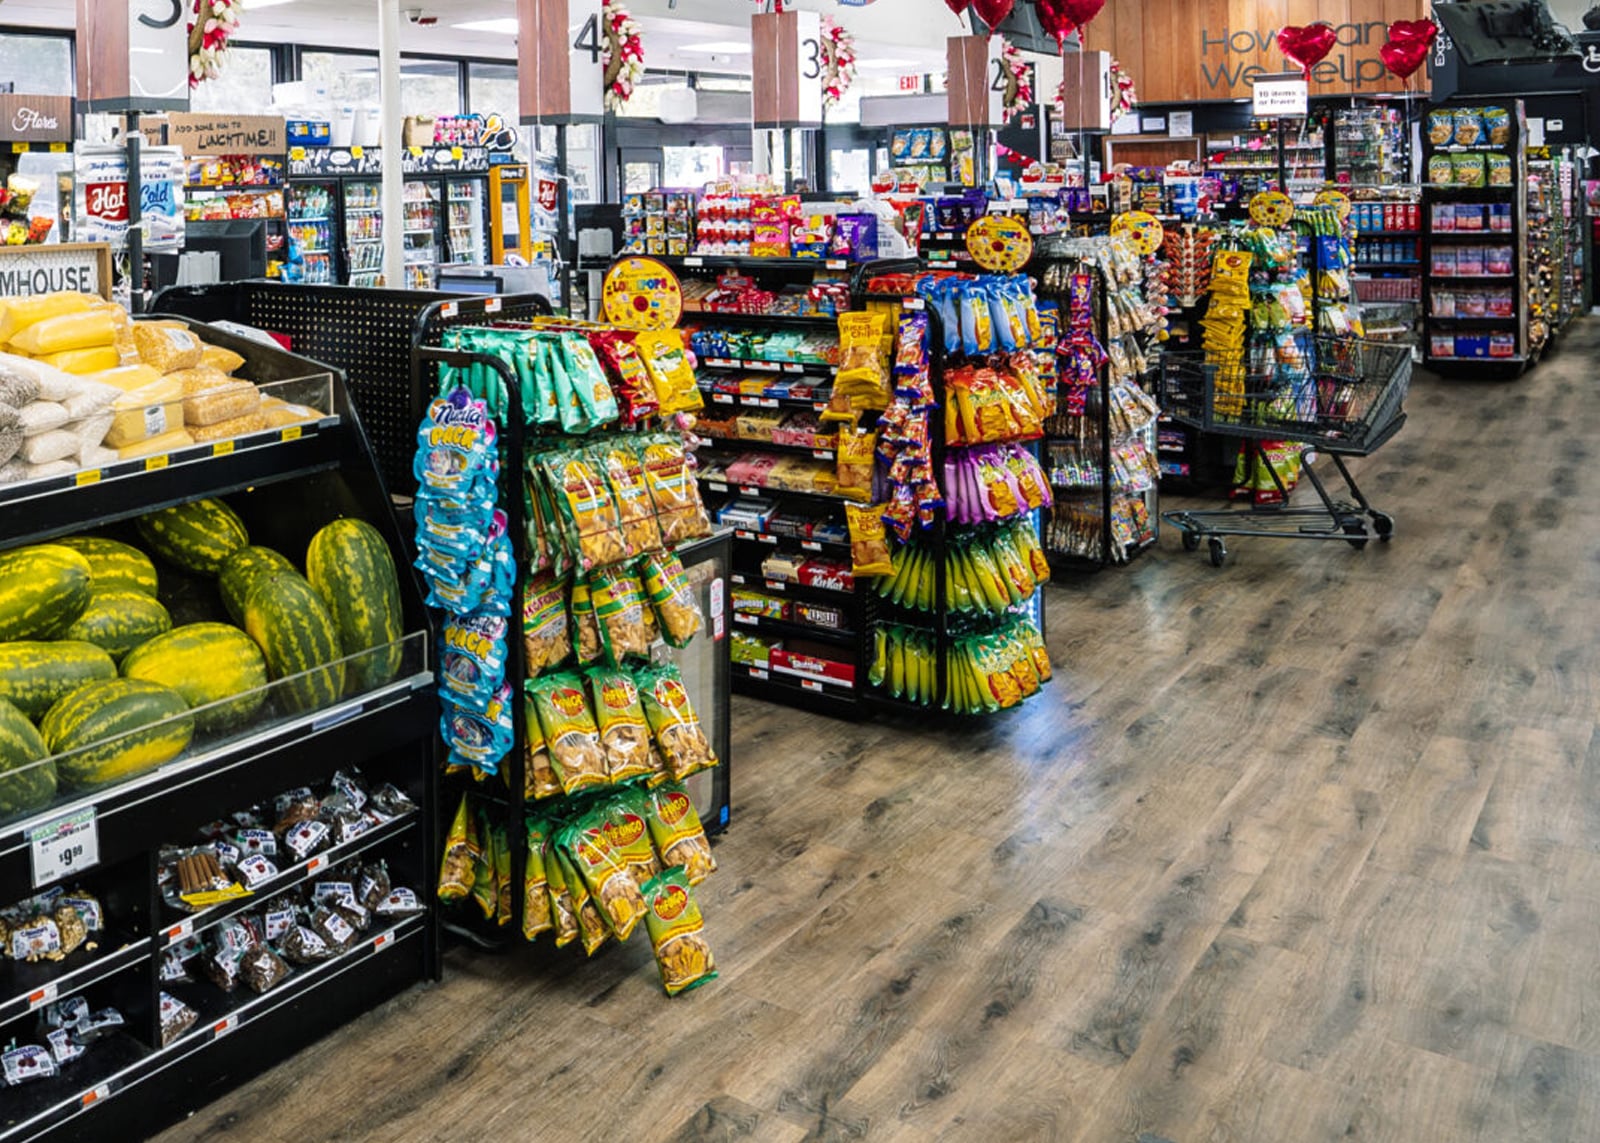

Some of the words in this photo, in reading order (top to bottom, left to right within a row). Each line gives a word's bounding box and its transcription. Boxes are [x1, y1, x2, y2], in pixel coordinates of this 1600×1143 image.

[574, 13, 603, 63] 4
[803, 39, 820, 79] 3
[1201, 61, 1268, 90] We
[1283, 54, 1395, 88] elp
[899, 75, 919, 91] EXIT
[991, 58, 1006, 91] 2
[1103, 71, 1109, 99] 1
[12, 107, 58, 132] Flores
[174, 125, 193, 134] ADD
[193, 122, 214, 133] SOME
[91, 184, 127, 213] Hot
[139, 180, 169, 205] Cold
[430, 425, 479, 450] PACK
